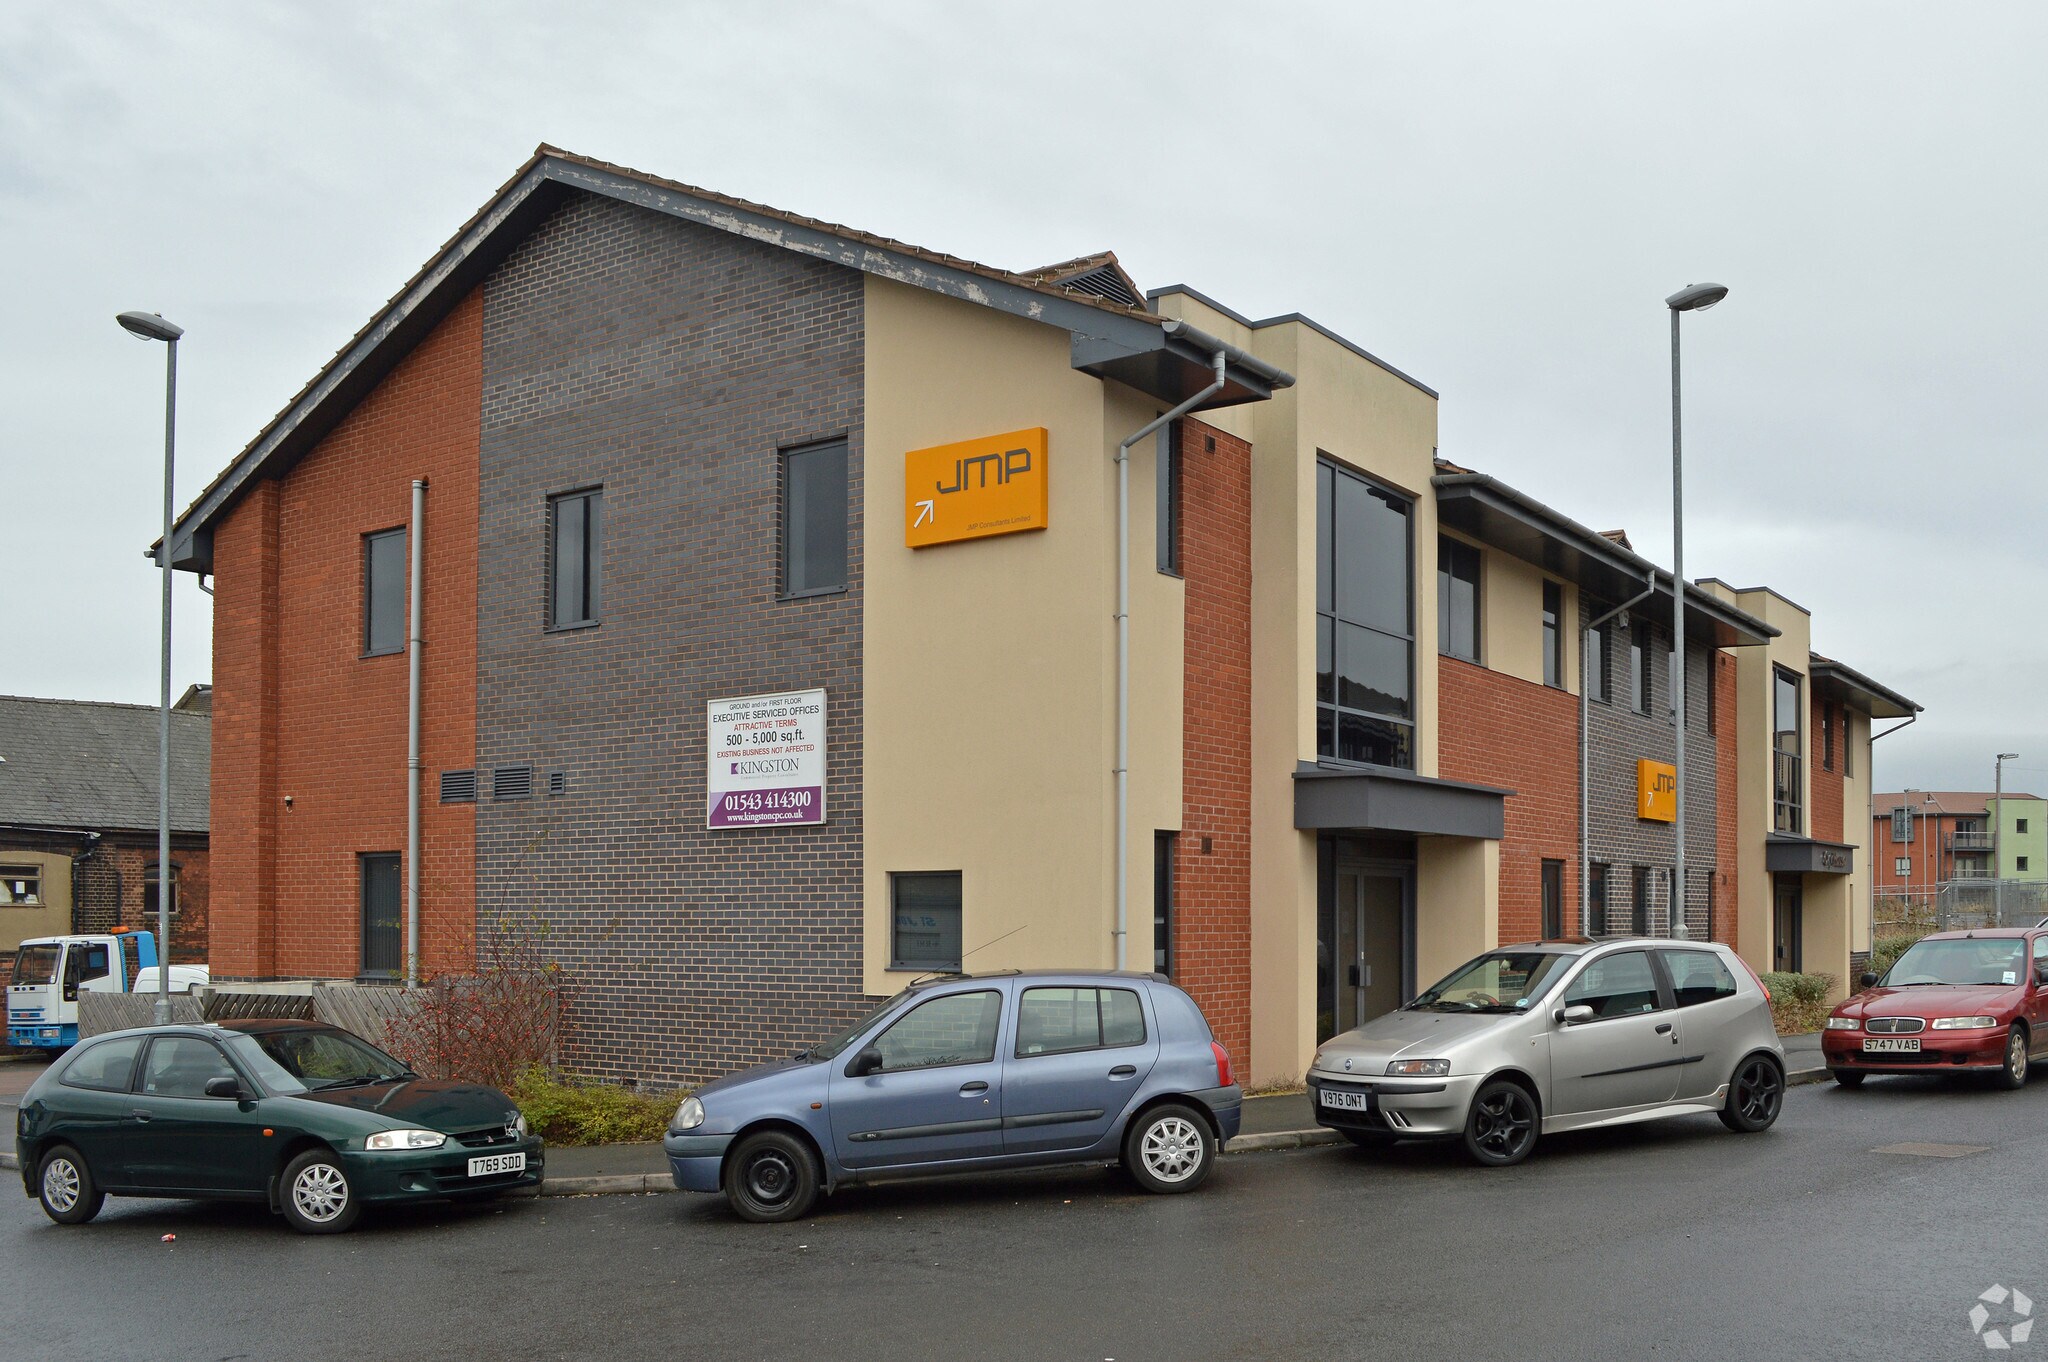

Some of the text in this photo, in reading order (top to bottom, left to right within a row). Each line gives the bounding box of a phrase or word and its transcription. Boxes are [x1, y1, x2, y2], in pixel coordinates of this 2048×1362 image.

[936, 448, 1031, 494] JMP
[979, 519, 1010, 528] Consultants
[1011, 515, 1030, 523] Limited
[730, 702, 750, 710] GROUND
[785, 697, 801, 705] FLOOR
[713, 705, 820, 722] EXECUTIVE SERVICED OFFICES
[734, 719, 797, 731] ATTRACTIVE TERMS
[726, 734, 742, 746] 500
[752, 732, 777, 745] 5,000
[781, 729, 804, 744] sq.ft.
[743, 748, 769, 756] BUSINESS
[785, 744, 814, 752] AFFECTED
[740, 758, 799, 774] KINGSTON
[725, 791, 811, 810] 01543 414300
[727, 809, 803, 822] www.kingstoncpc.co.uk
[1864, 1040, 1918, 1050] S747 VAB
[1323, 1091, 1362, 1107] Y976 ONT
[473, 1155, 521, 1173] T769 SDD
